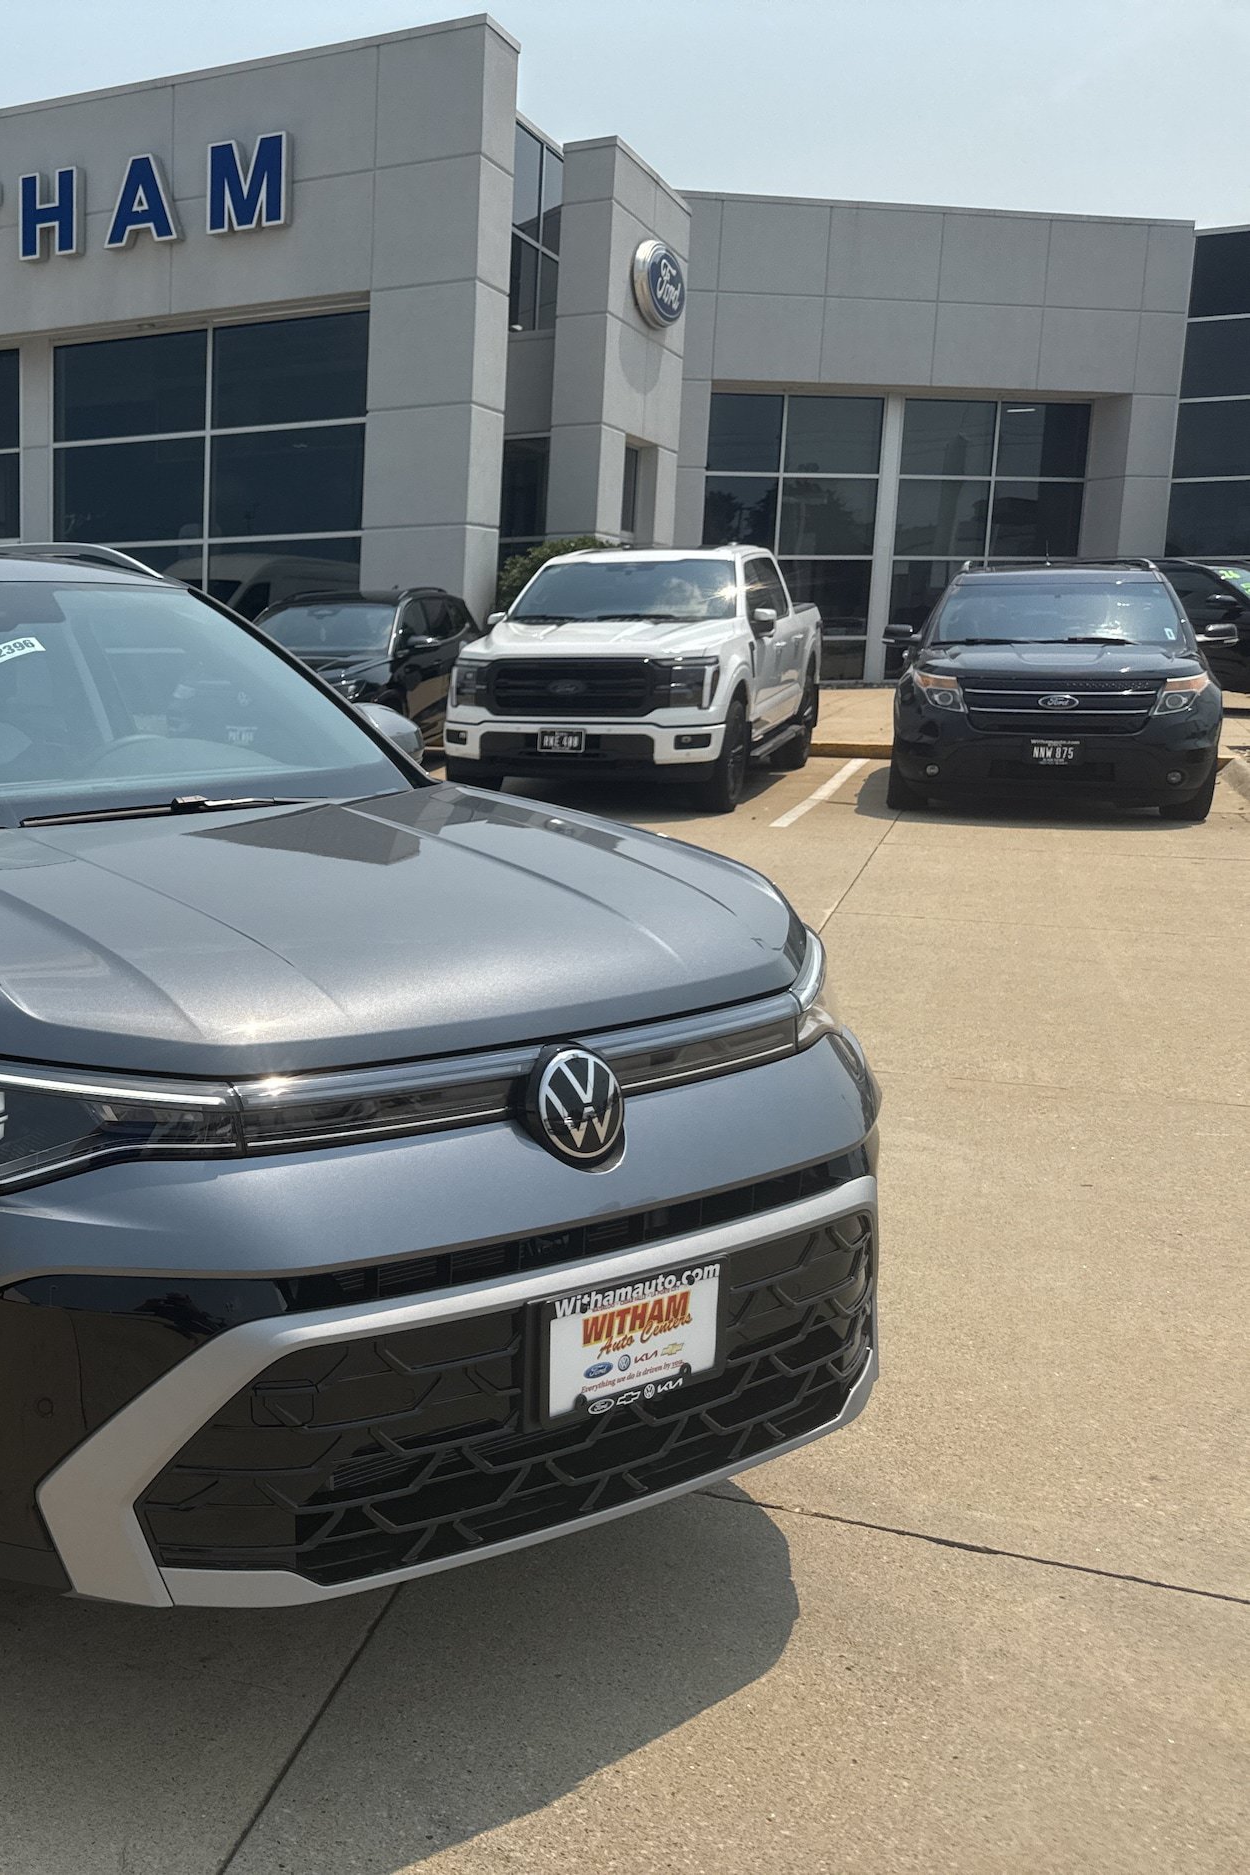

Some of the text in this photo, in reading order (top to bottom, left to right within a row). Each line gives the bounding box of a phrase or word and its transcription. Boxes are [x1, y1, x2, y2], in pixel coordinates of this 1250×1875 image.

[656, 258, 682, 311] Ford
[1055, 746, 1074, 759] 875
[582, 1290, 691, 1347] WITHAM
[597, 1313, 692, 1360] Auto Centers
[580, 1377, 616, 1394] Everything
[626, 1372, 635, 1381] do
[642, 1365, 663, 1376] driven
